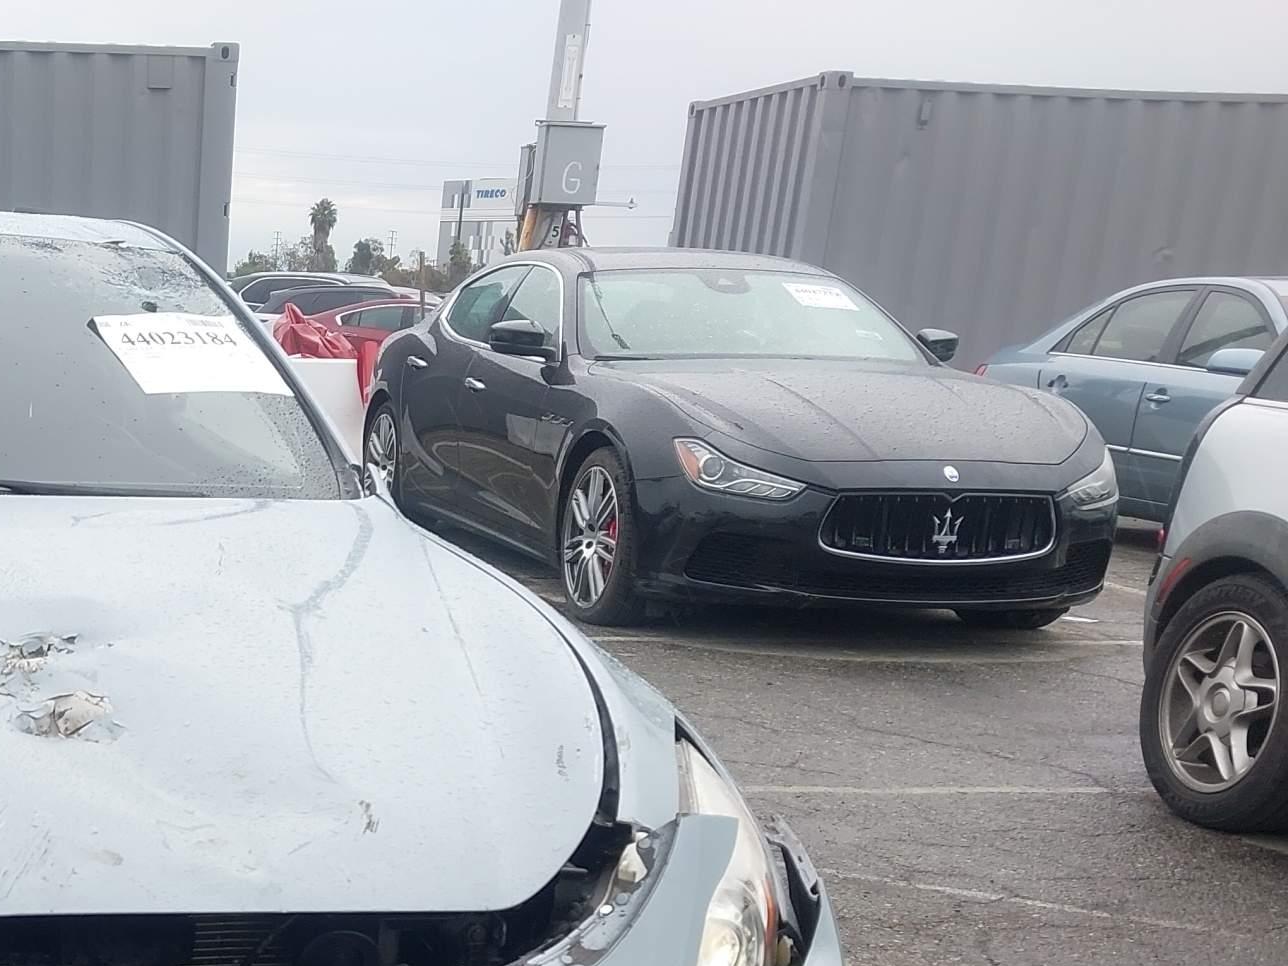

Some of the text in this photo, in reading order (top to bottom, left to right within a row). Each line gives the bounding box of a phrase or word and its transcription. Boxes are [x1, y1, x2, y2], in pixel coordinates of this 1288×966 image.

[562, 161, 582, 194] G
[476, 189, 506, 199] TIRECO
[551, 225, 560, 238] 5
[121, 331, 237, 346] 44023184
